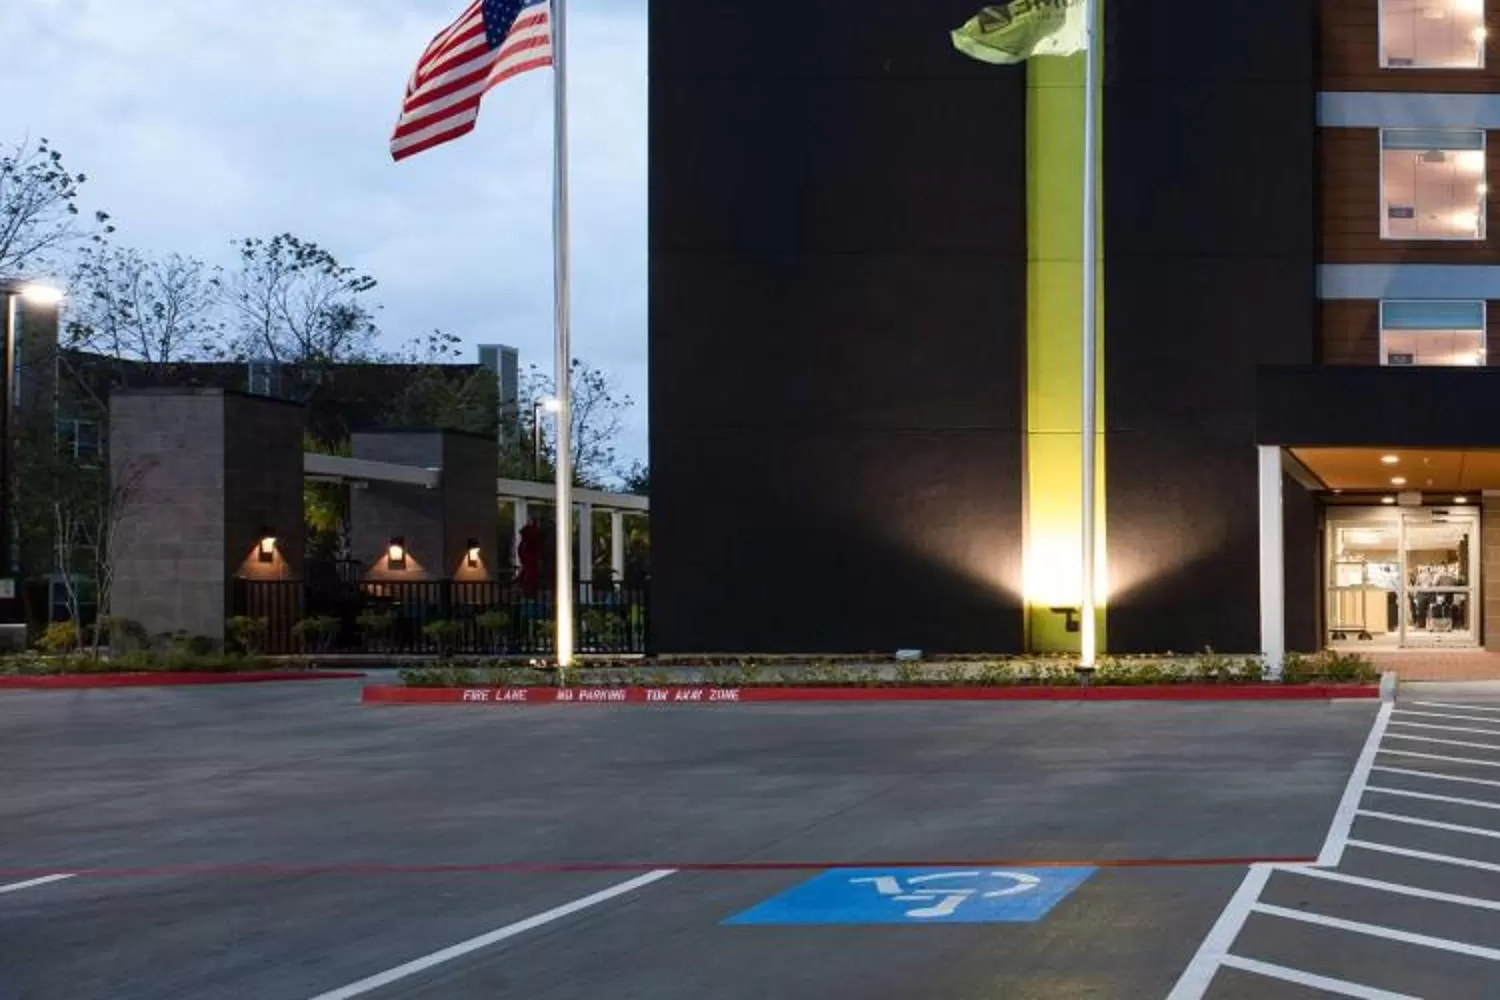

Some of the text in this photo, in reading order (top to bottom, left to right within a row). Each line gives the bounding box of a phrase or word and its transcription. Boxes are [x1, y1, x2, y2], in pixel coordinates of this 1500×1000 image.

[462, 688, 491, 701] FIRE
[494, 688, 528, 701] LANE
[578, 688, 627, 701] PARKING
[645, 688, 669, 701] TOW
[708, 688, 741, 701] ZONE
